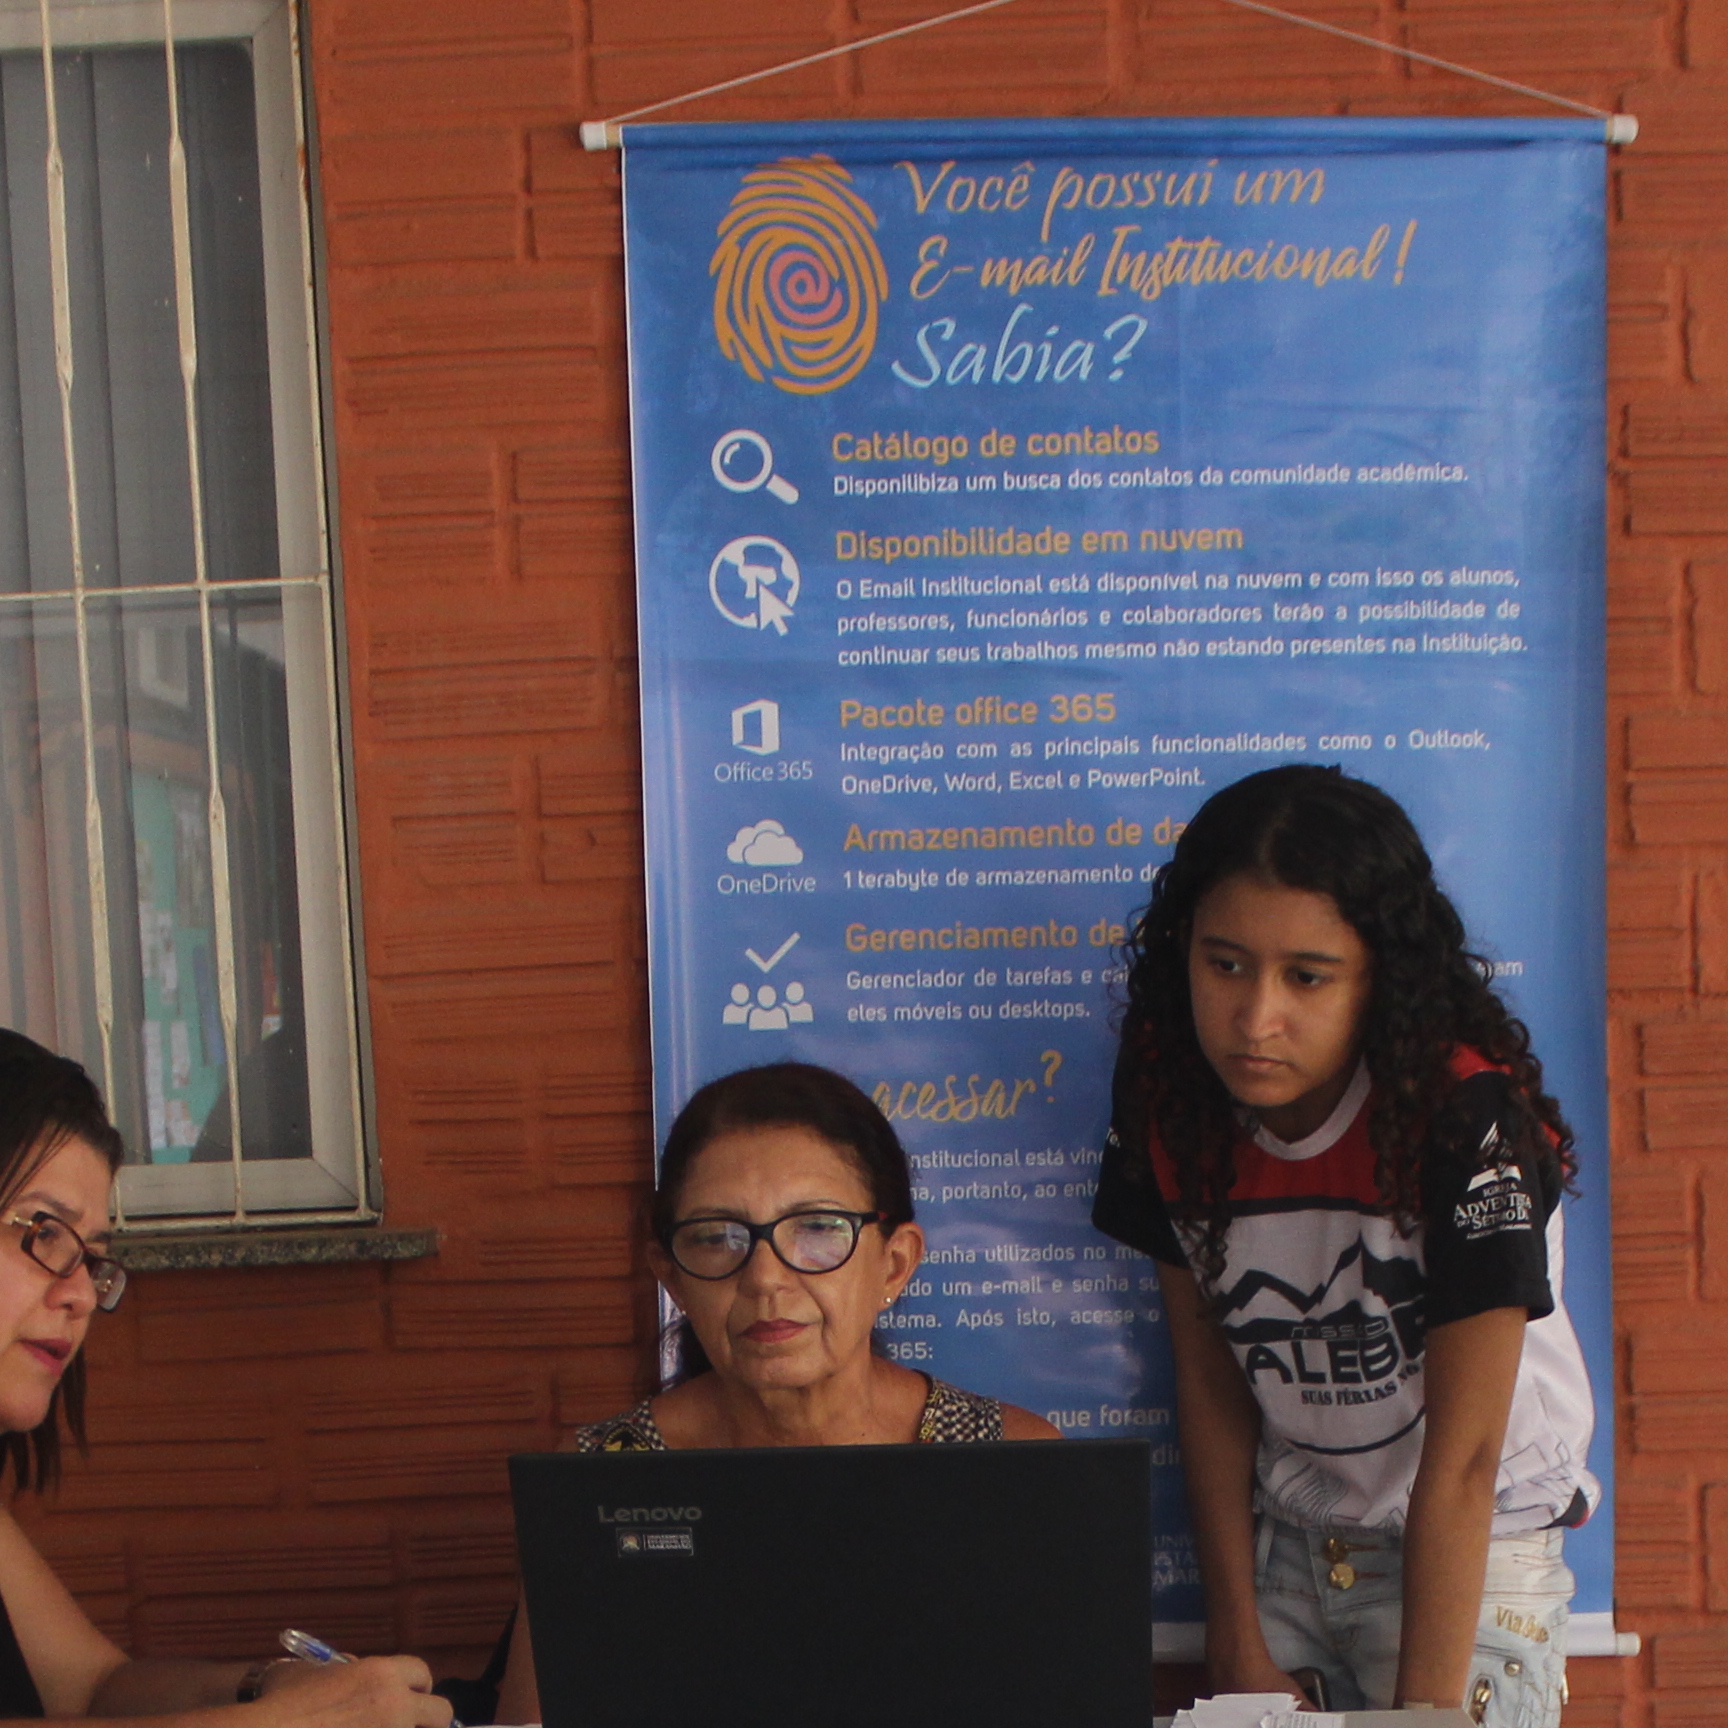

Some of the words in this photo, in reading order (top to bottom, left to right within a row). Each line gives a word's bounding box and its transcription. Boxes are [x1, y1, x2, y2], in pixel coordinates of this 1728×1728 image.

[893, 160, 1030, 214] Você
[1041, 158, 1217, 243] possui
[1234, 167, 1326, 208] um
[910, 233, 1093, 300] E-mail
[892, 304, 1146, 389] Sabia?
[831, 429, 970, 467] Catálogo
[978, 426, 1018, 459] de
[1025, 423, 1161, 457] contatos
[833, 471, 960, 499] Disponilibiza
[965, 473, 997, 492] um
[1002, 469, 1062, 491] busca
[1067, 466, 1104, 489] dos
[1107, 465, 1194, 489] contatos
[1199, 464, 1225, 486] da
[1229, 461, 1352, 485] comunidade
[1355, 461, 1470, 484] acadêmica.
[835, 524, 1072, 565] Disponibilidade
[1080, 528, 1130, 554] em
[1139, 526, 1245, 552] nuvem
[837, 610, 956, 637] professores,
[966, 606, 1089, 629] funcionários
[1098, 608, 1112, 626] e
[1122, 602, 1263, 625] colaboradores
[1273, 601, 1326, 622] terão
[1335, 604, 1349, 622] a
[1358, 598, 1487, 625] possibilidade
[1495, 597, 1522, 620] de
[839, 697, 946, 729] Pacote
[954, 695, 1040, 727] office
[1048, 691, 1117, 724] 365
[840, 741, 944, 765] Integração
[956, 742, 998, 758] com
[1010, 741, 1033, 757] as
[1044, 735, 1140, 760] principais
[1152, 732, 1307, 754] funcionalidades
[1318, 734, 1372, 750] como
[1384, 734, 1397, 749] o
[1409, 729, 1491, 750] Outlook,
[714, 761, 774, 783] Office
[777, 759, 814, 781] 365
[841, 773, 938, 795] OneDrive,
[944, 771, 1002, 793] Word,
[1009, 769, 1063, 790] Excel
[1069, 773, 1081, 789] e
[1087, 766, 1206, 788] PowerPoint.
[842, 817, 1096, 852] Armazenamento
[1105, 815, 1145, 847] de
[717, 871, 817, 894] OneDrive
[845, 918, 1079, 953] Gerenciamento
[1087, 917, 1130, 953] de
[910, 1148, 1020, 1169] nstitucional
[942, 1179, 1028, 1203] portanto,
[1034, 1184, 1057, 1198] ao
[921, 1246, 976, 1264] senha
[985, 1244, 1074, 1263] utilizados
[1083, 1246, 1107, 1260] no
[597, 1505, 703, 1522] Lenovo
